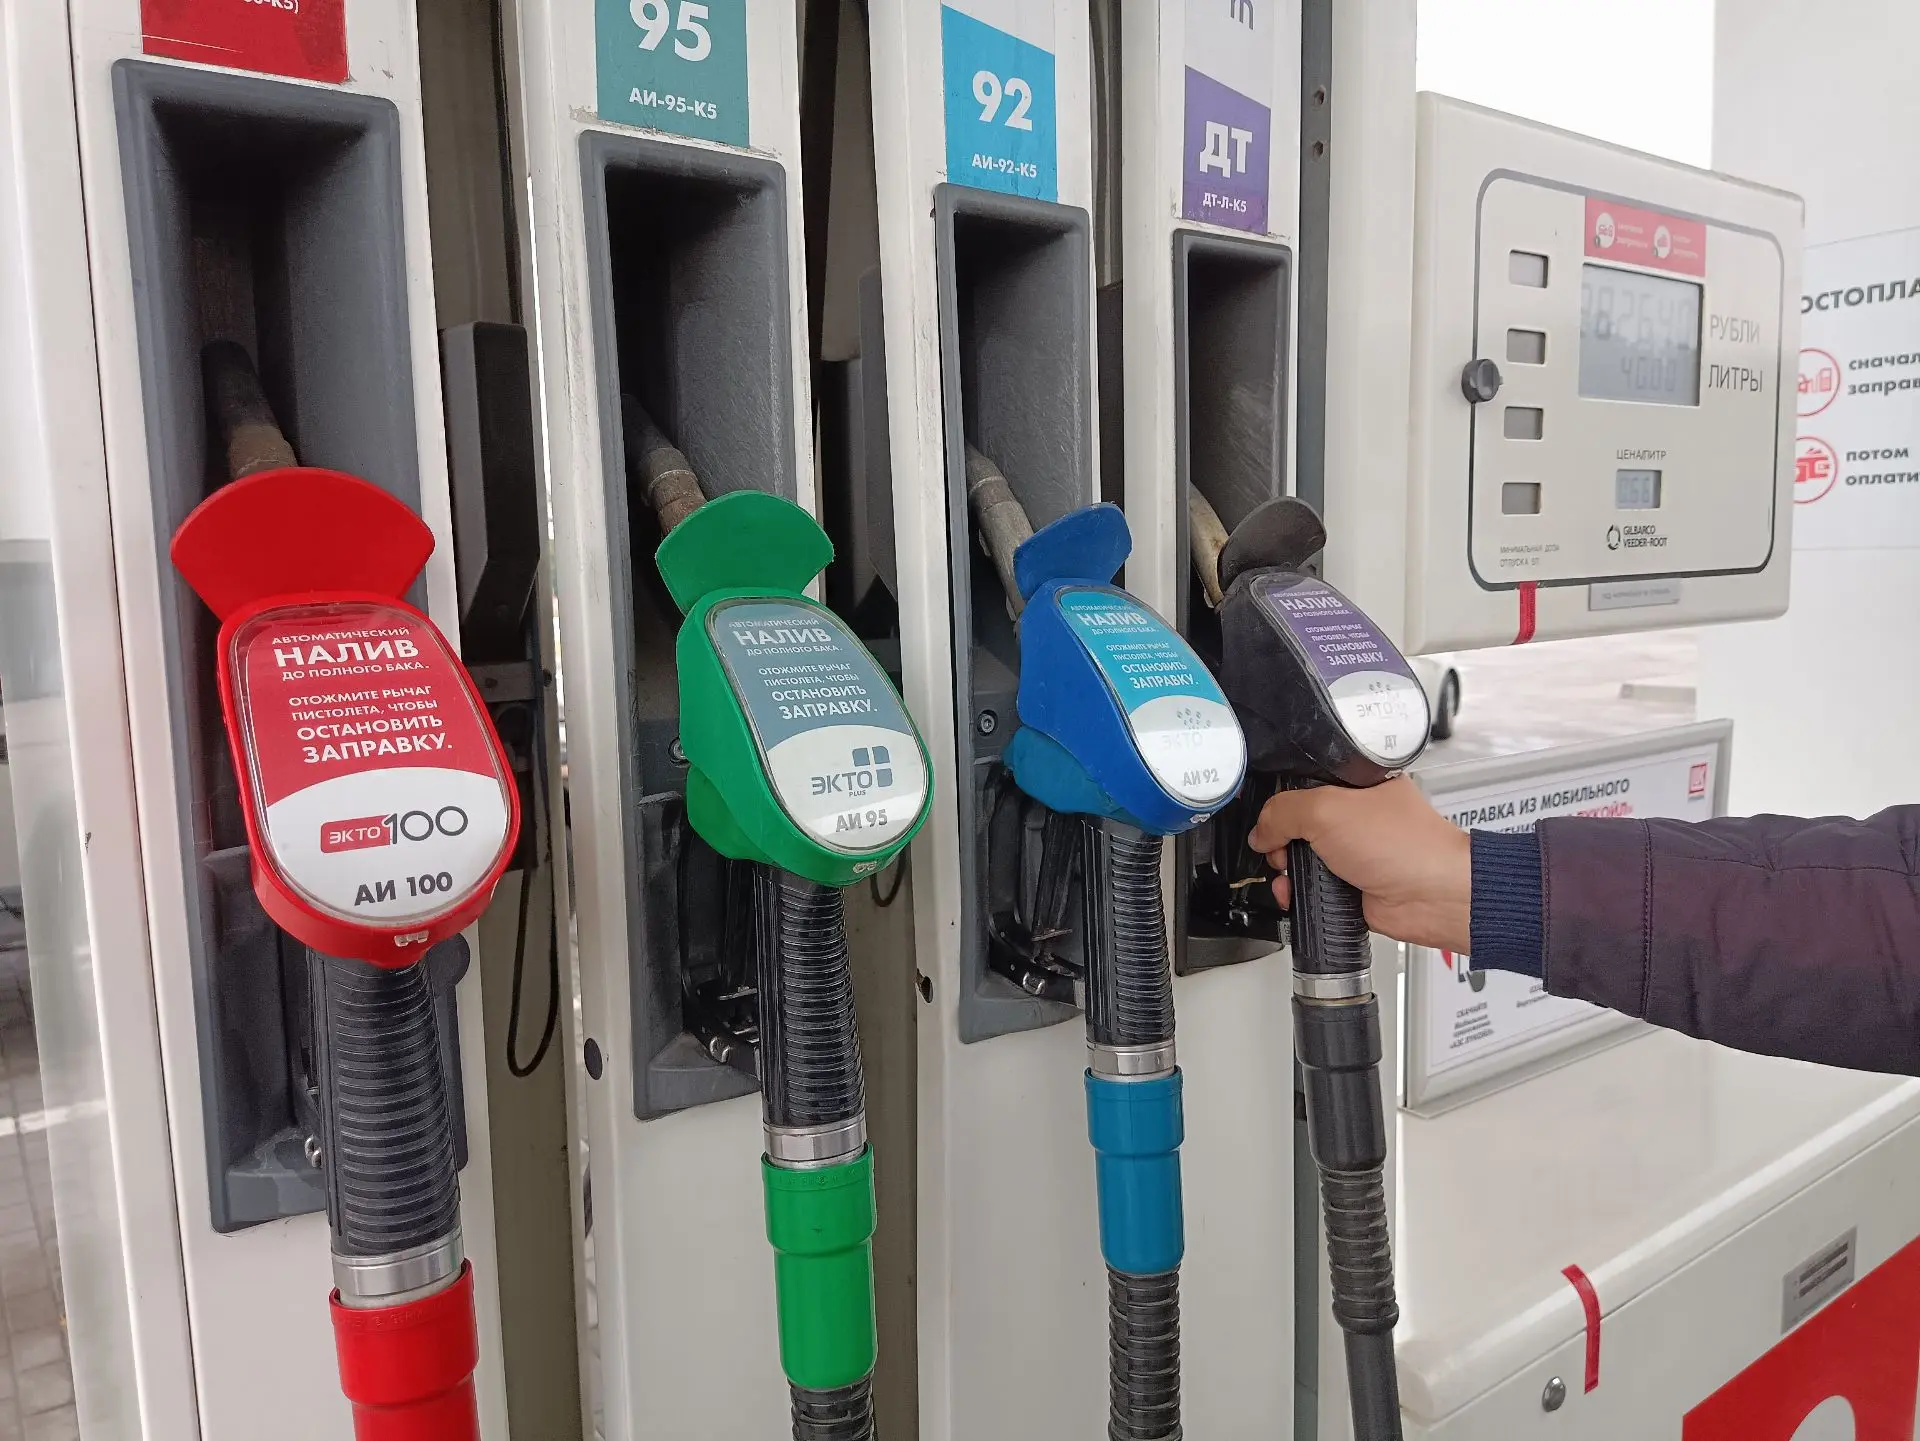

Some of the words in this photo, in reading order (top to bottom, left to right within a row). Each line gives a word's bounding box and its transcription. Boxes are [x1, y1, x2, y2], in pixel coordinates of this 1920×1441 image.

[629, 0, 712, 61] 95
[629, 87, 717, 120] АИ-95-К5
[972, 70, 1033, 131] 92
[1199, 121, 1252, 178] ДТ
[971, 153, 1037, 179] АИ-92-К5
[1203, 192, 1247, 213] ДТ-Л-К5
[1710, 314, 1760, 344] РУБЛИ
[1708, 364, 1763, 392] ЛИТРЫ
[1846, 447, 1909, 462] потом
[1623, 525, 1656, 535] GILBARCO
[1623, 537, 1668, 548] VEEDER-ROOT
[1279, 596, 1343, 611] НАЛИВ
[728, 617, 820, 628] АВТОМАТИЧЕСКИЙ
[1077, 612, 1147, 627] НАЛИВ
[1305, 625, 1342, 633] ОТОЖМИТЕ
[271, 627, 410, 645] АВТОМАТИЧЕСКИЙ
[732, 627, 832, 647] НАЛИВ
[273, 639, 420, 667] НАЛИВ
[746, 647, 762, 657] ДО
[763, 646, 812, 656] ПОЛНОГО
[1106, 643, 1148, 651] ОТОЖМИТЕ
[1113, 652, 1155, 661] ПИСТОЛЕТА,
[1319, 641, 1378, 653] ОСТАНОВИТЬ
[1121, 661, 1187, 674] ОСТАНОВИТЬ
[1326, 652, 1388, 666] ЗАПРАВКУ.
[281, 669, 305, 681] ДО
[308, 664, 382, 678] ПОЛНОГО
[386, 661, 430, 672] БАКА.
[758, 664, 818, 676] ОТОЖМИТЕ
[819, 663, 852, 672] РЫЧАГ
[763, 676, 824, 687] ПИСТОЛЕТА,
[826, 674, 860, 683] ЧТОБЫ
[1130, 674, 1199, 689] ЗАПРАВКУ.
[288, 691, 380, 707] ОТОЖМИТЕ
[382, 686, 432, 699] РЫЧАГ
[771, 685, 867, 702] ОСТАНОВИТЬ
[291, 705, 385, 722] ПИСТОЛЕТА,
[388, 700, 438, 713] ЧТОБЫ
[778, 698, 878, 720] ЗАПРАВКУ.
[296, 714, 443, 741] ОСТАНОВИТЬ
[303, 732, 453, 763] ЗАПРАВКУ.
[1384, 735, 1397, 751] ДТ
[810, 770, 873, 796] ЭКТО
[1183, 771, 1201, 787] АИ
[1203, 768, 1219, 783] 92
[1443, 802, 1515, 828] АПРАВКА
[1520, 797, 1537, 815] ИЗ
[1540, 778, 1630, 811] МОБИЛЬНОГО
[329, 826, 382, 844] ЭКТО
[383, 806, 469, 845] 100
[835, 811, 862, 833] АИ
[865, 808, 888, 828] 95
[354, 880, 397, 906] АИ
[406, 872, 453, 896] 100
